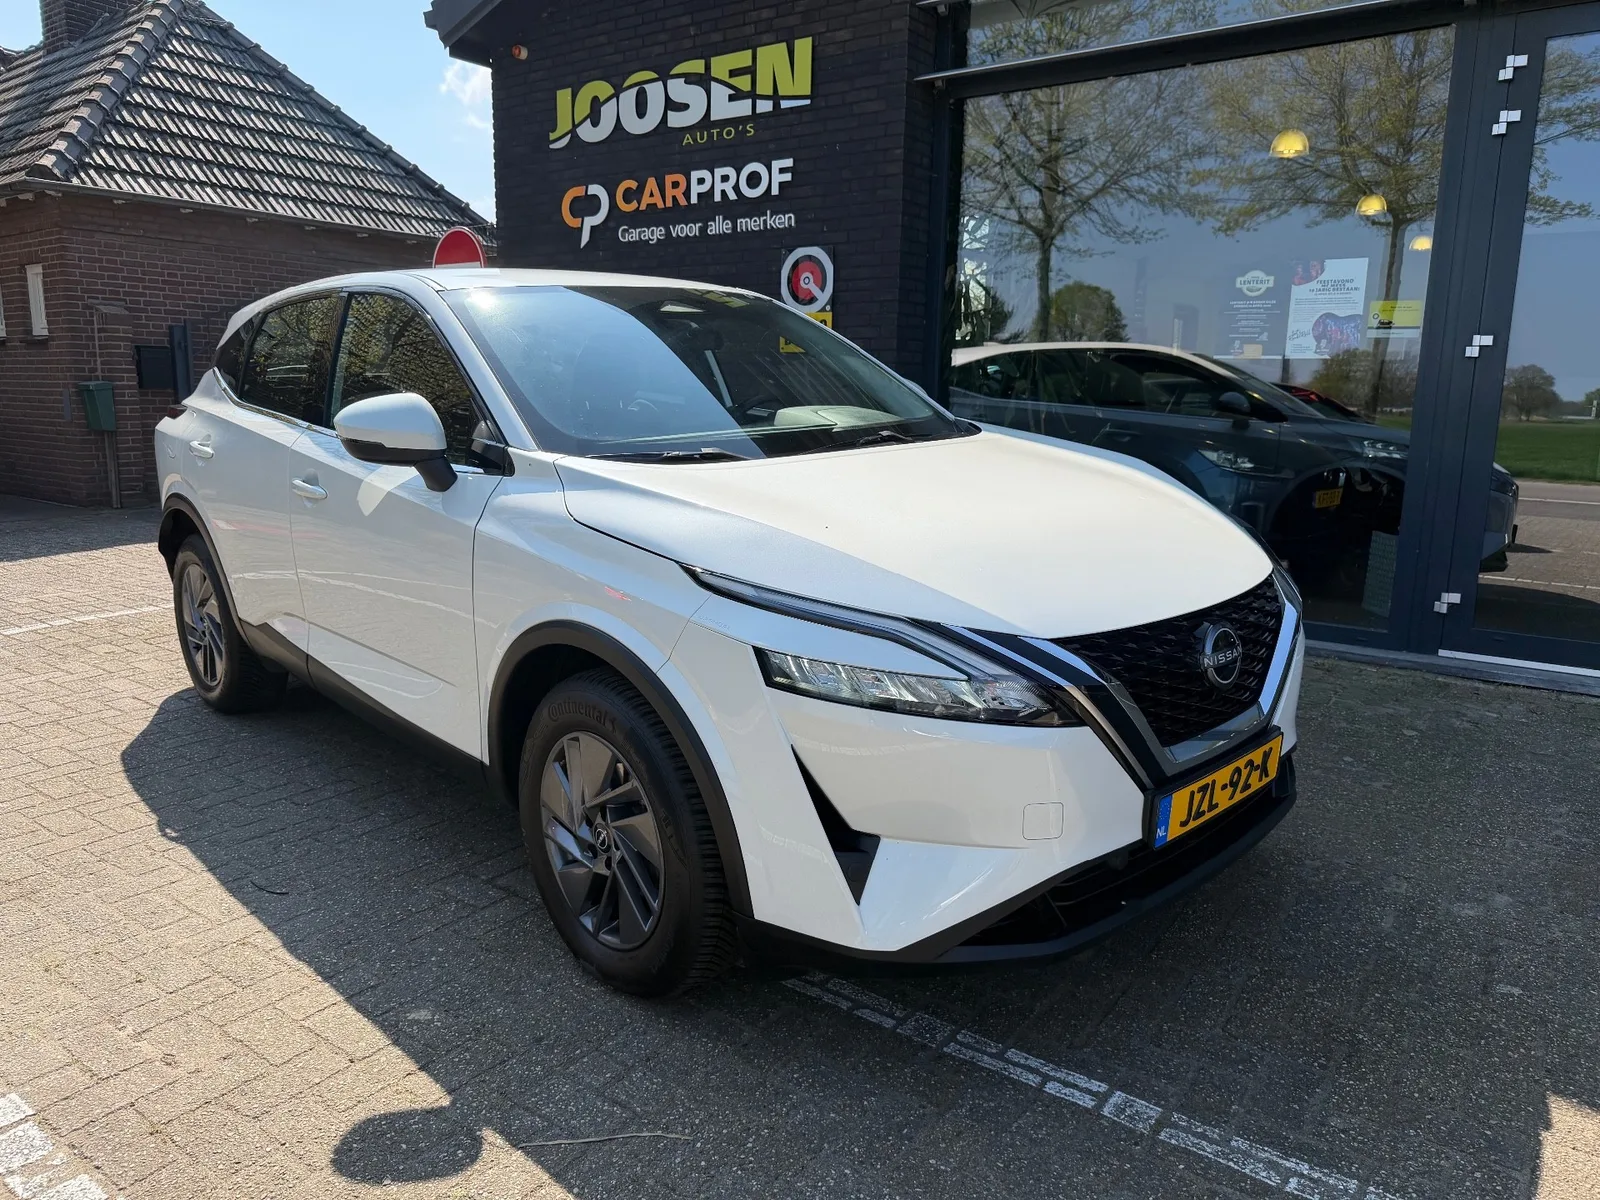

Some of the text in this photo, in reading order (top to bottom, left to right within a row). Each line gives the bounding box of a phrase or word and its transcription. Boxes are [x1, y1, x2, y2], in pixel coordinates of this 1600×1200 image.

[549, 37, 813, 149] JOOSEN
[682, 123, 756, 146] AUTO'S
[615, 157, 794, 213] CARPROF
[618, 210, 795, 244] Garage voor alle merken
[1203, 645, 1242, 667] NISSAN
[548, 697, 607, 728] Continental
[1179, 747, 1273, 827] JZL-92-K
[1156, 826, 1167, 839] NL
